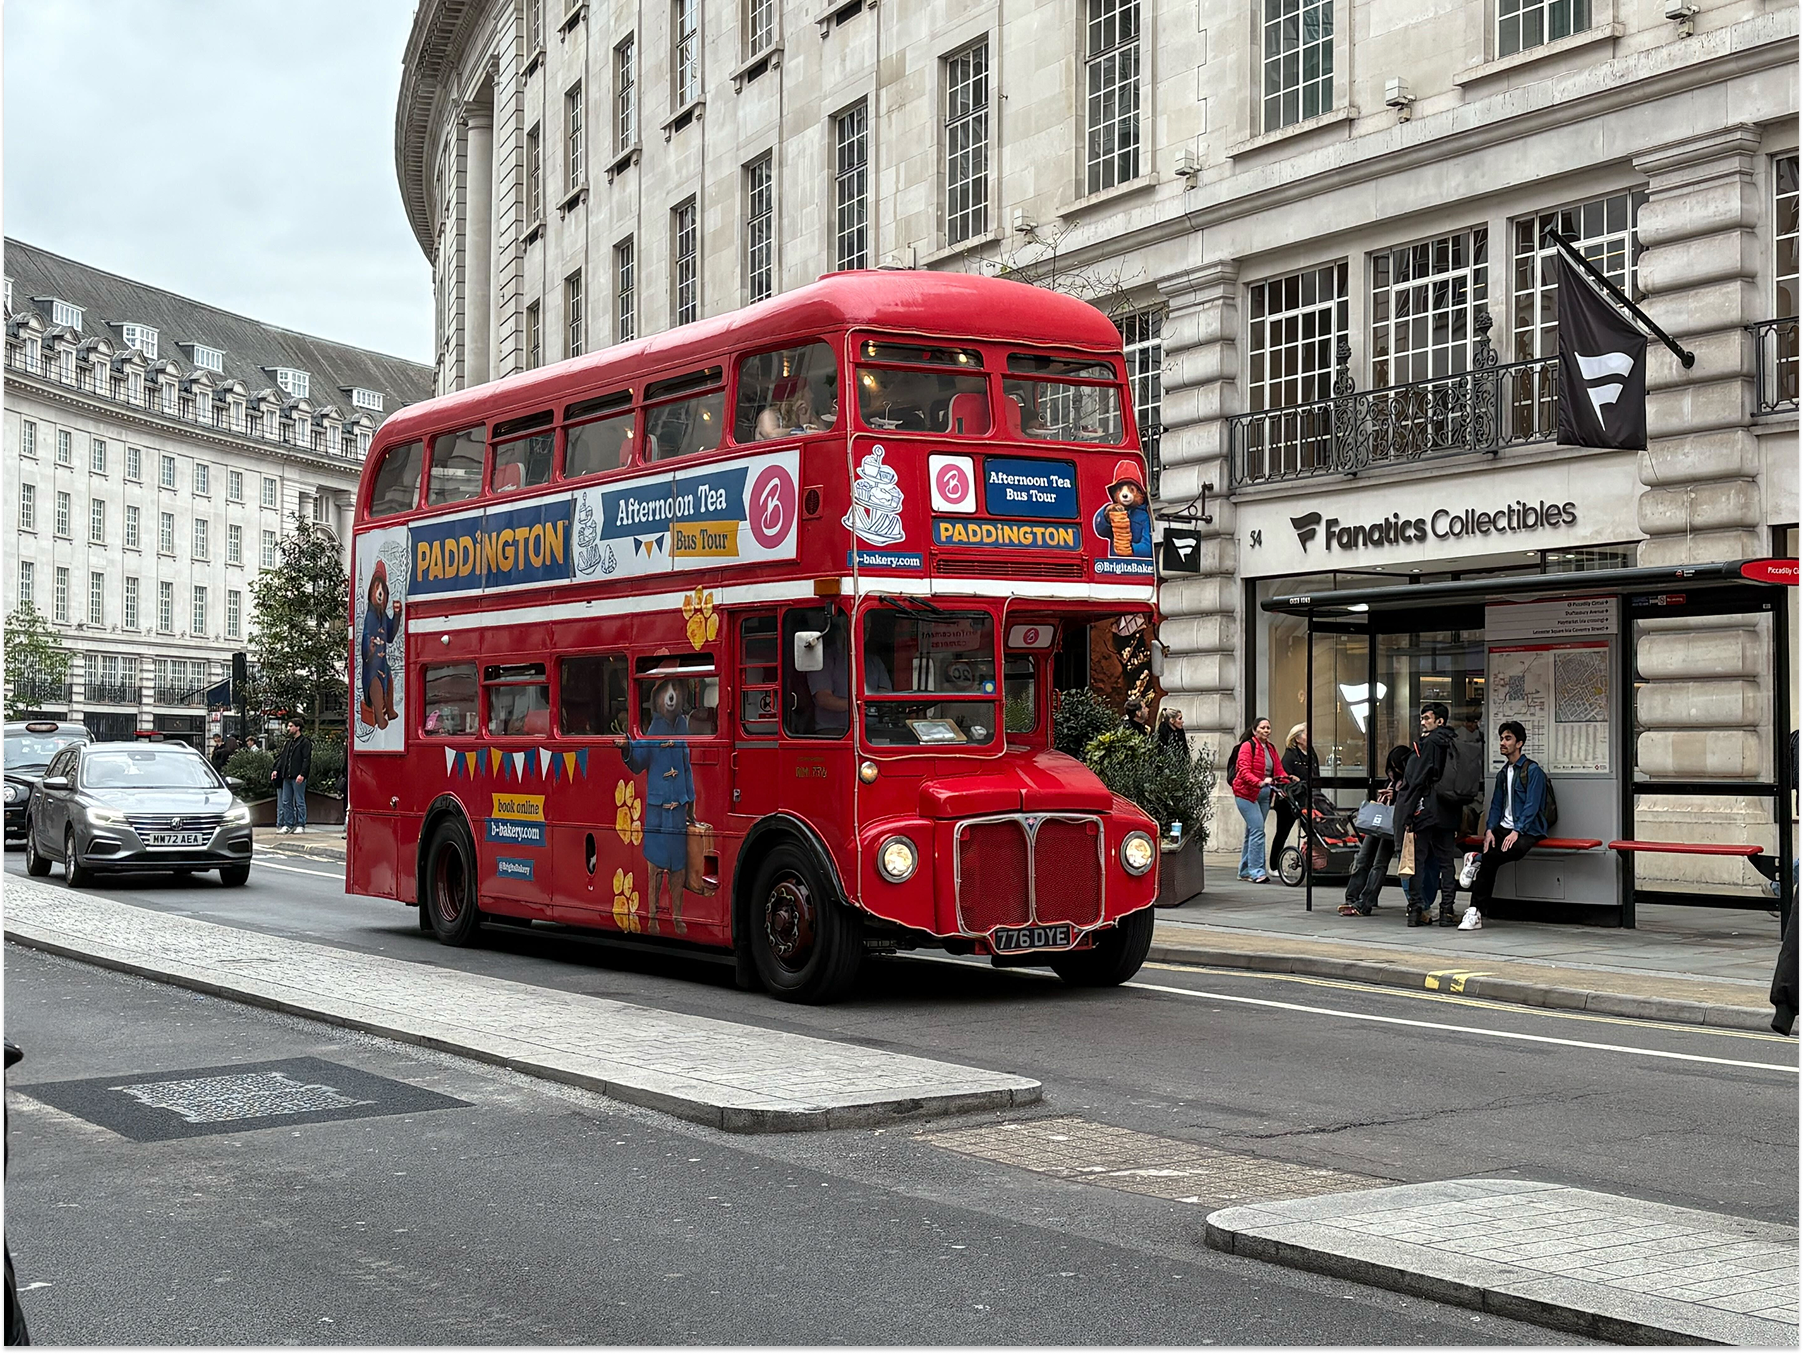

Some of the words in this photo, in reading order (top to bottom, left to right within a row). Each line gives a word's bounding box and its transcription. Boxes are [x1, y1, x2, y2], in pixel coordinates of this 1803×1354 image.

[989, 471, 1048, 487] Afternoon
[1050, 475, 1071, 488] Tea
[1006, 488, 1028, 502] Bus
[1030, 490, 1057, 503] Tour
[616, 496, 694, 526] Afternoon
[698, 484, 727, 513] Tea
[1325, 512, 1427, 551] Fanatics
[1431, 500, 1578, 539] Collectibles
[676, 530, 697, 550] Bus
[699, 528, 728, 550] Tour
[853, 554, 920, 568] -bakery.com
[1767, 566, 1792, 576] Piccadilly
[498, 799, 515, 813] book
[516, 800, 540, 815] online
[180, 834, 199, 844] AEA
[491, 822, 540, 841] b-bakery.com
[997, 930, 1030, 948] 776
[1034, 927, 1068, 945] DYE
